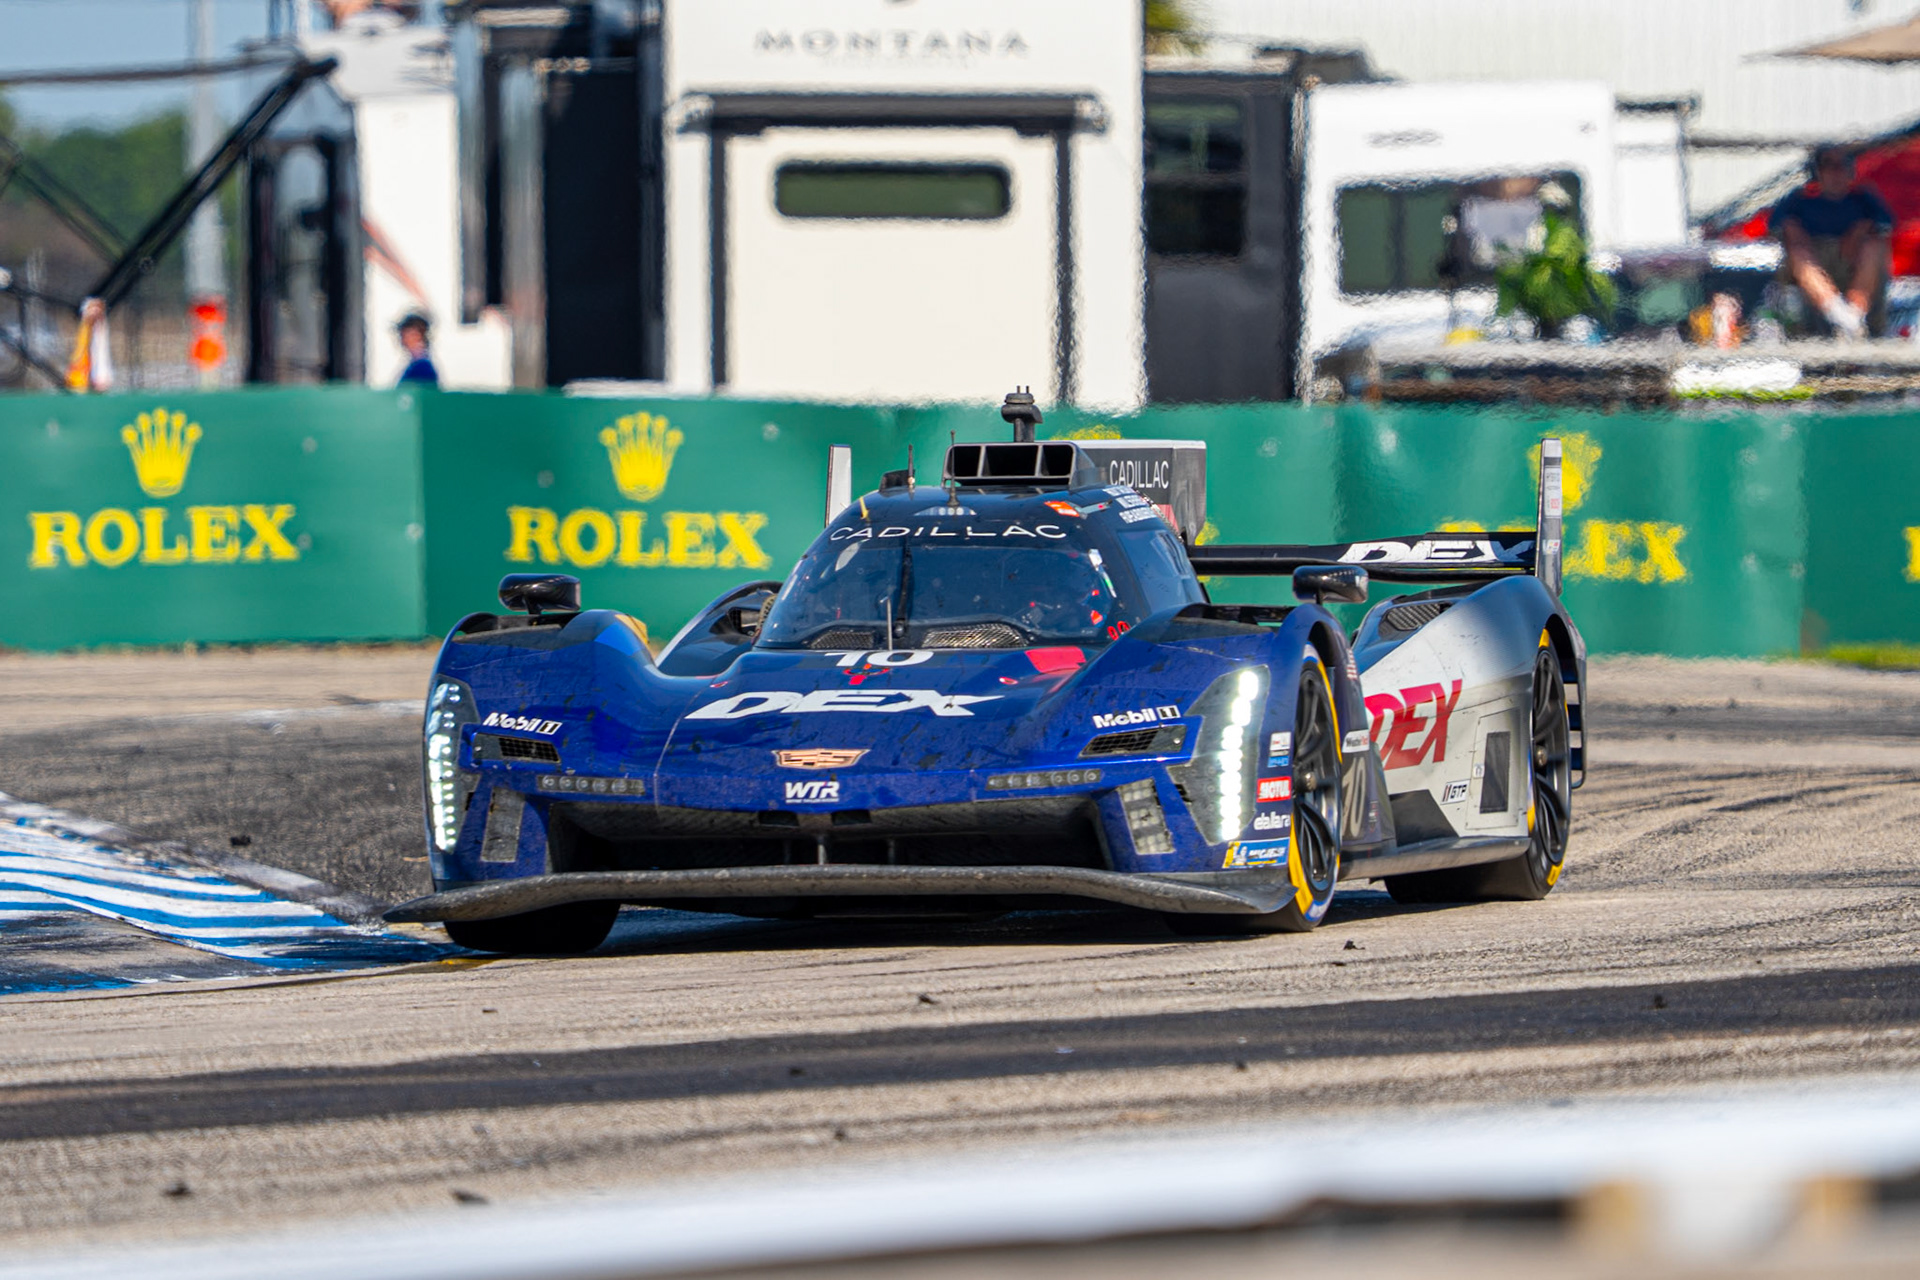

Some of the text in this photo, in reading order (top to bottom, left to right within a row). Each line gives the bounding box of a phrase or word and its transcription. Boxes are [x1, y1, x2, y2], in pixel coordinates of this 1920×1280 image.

[753, 29, 1030, 57] MONTANA
[1109, 460, 1169, 489] CADILLAC
[27, 503, 299, 569] ROLEX
[504, 505, 772, 569] ROLEX
[829, 525, 1067, 541] CADILLAC
[824, 649, 934, 667] 10
[684, 689, 1005, 720] DEX
[482, 712, 542, 732] Mobil
[1092, 708, 1157, 728] Mobil
[1364, 678, 1463, 771] DEX
[785, 781, 840, 799] WTR
[1259, 779, 1290, 798] MOTUL
[1342, 757, 1367, 838] 10
[1450, 784, 1467, 799] GTP
